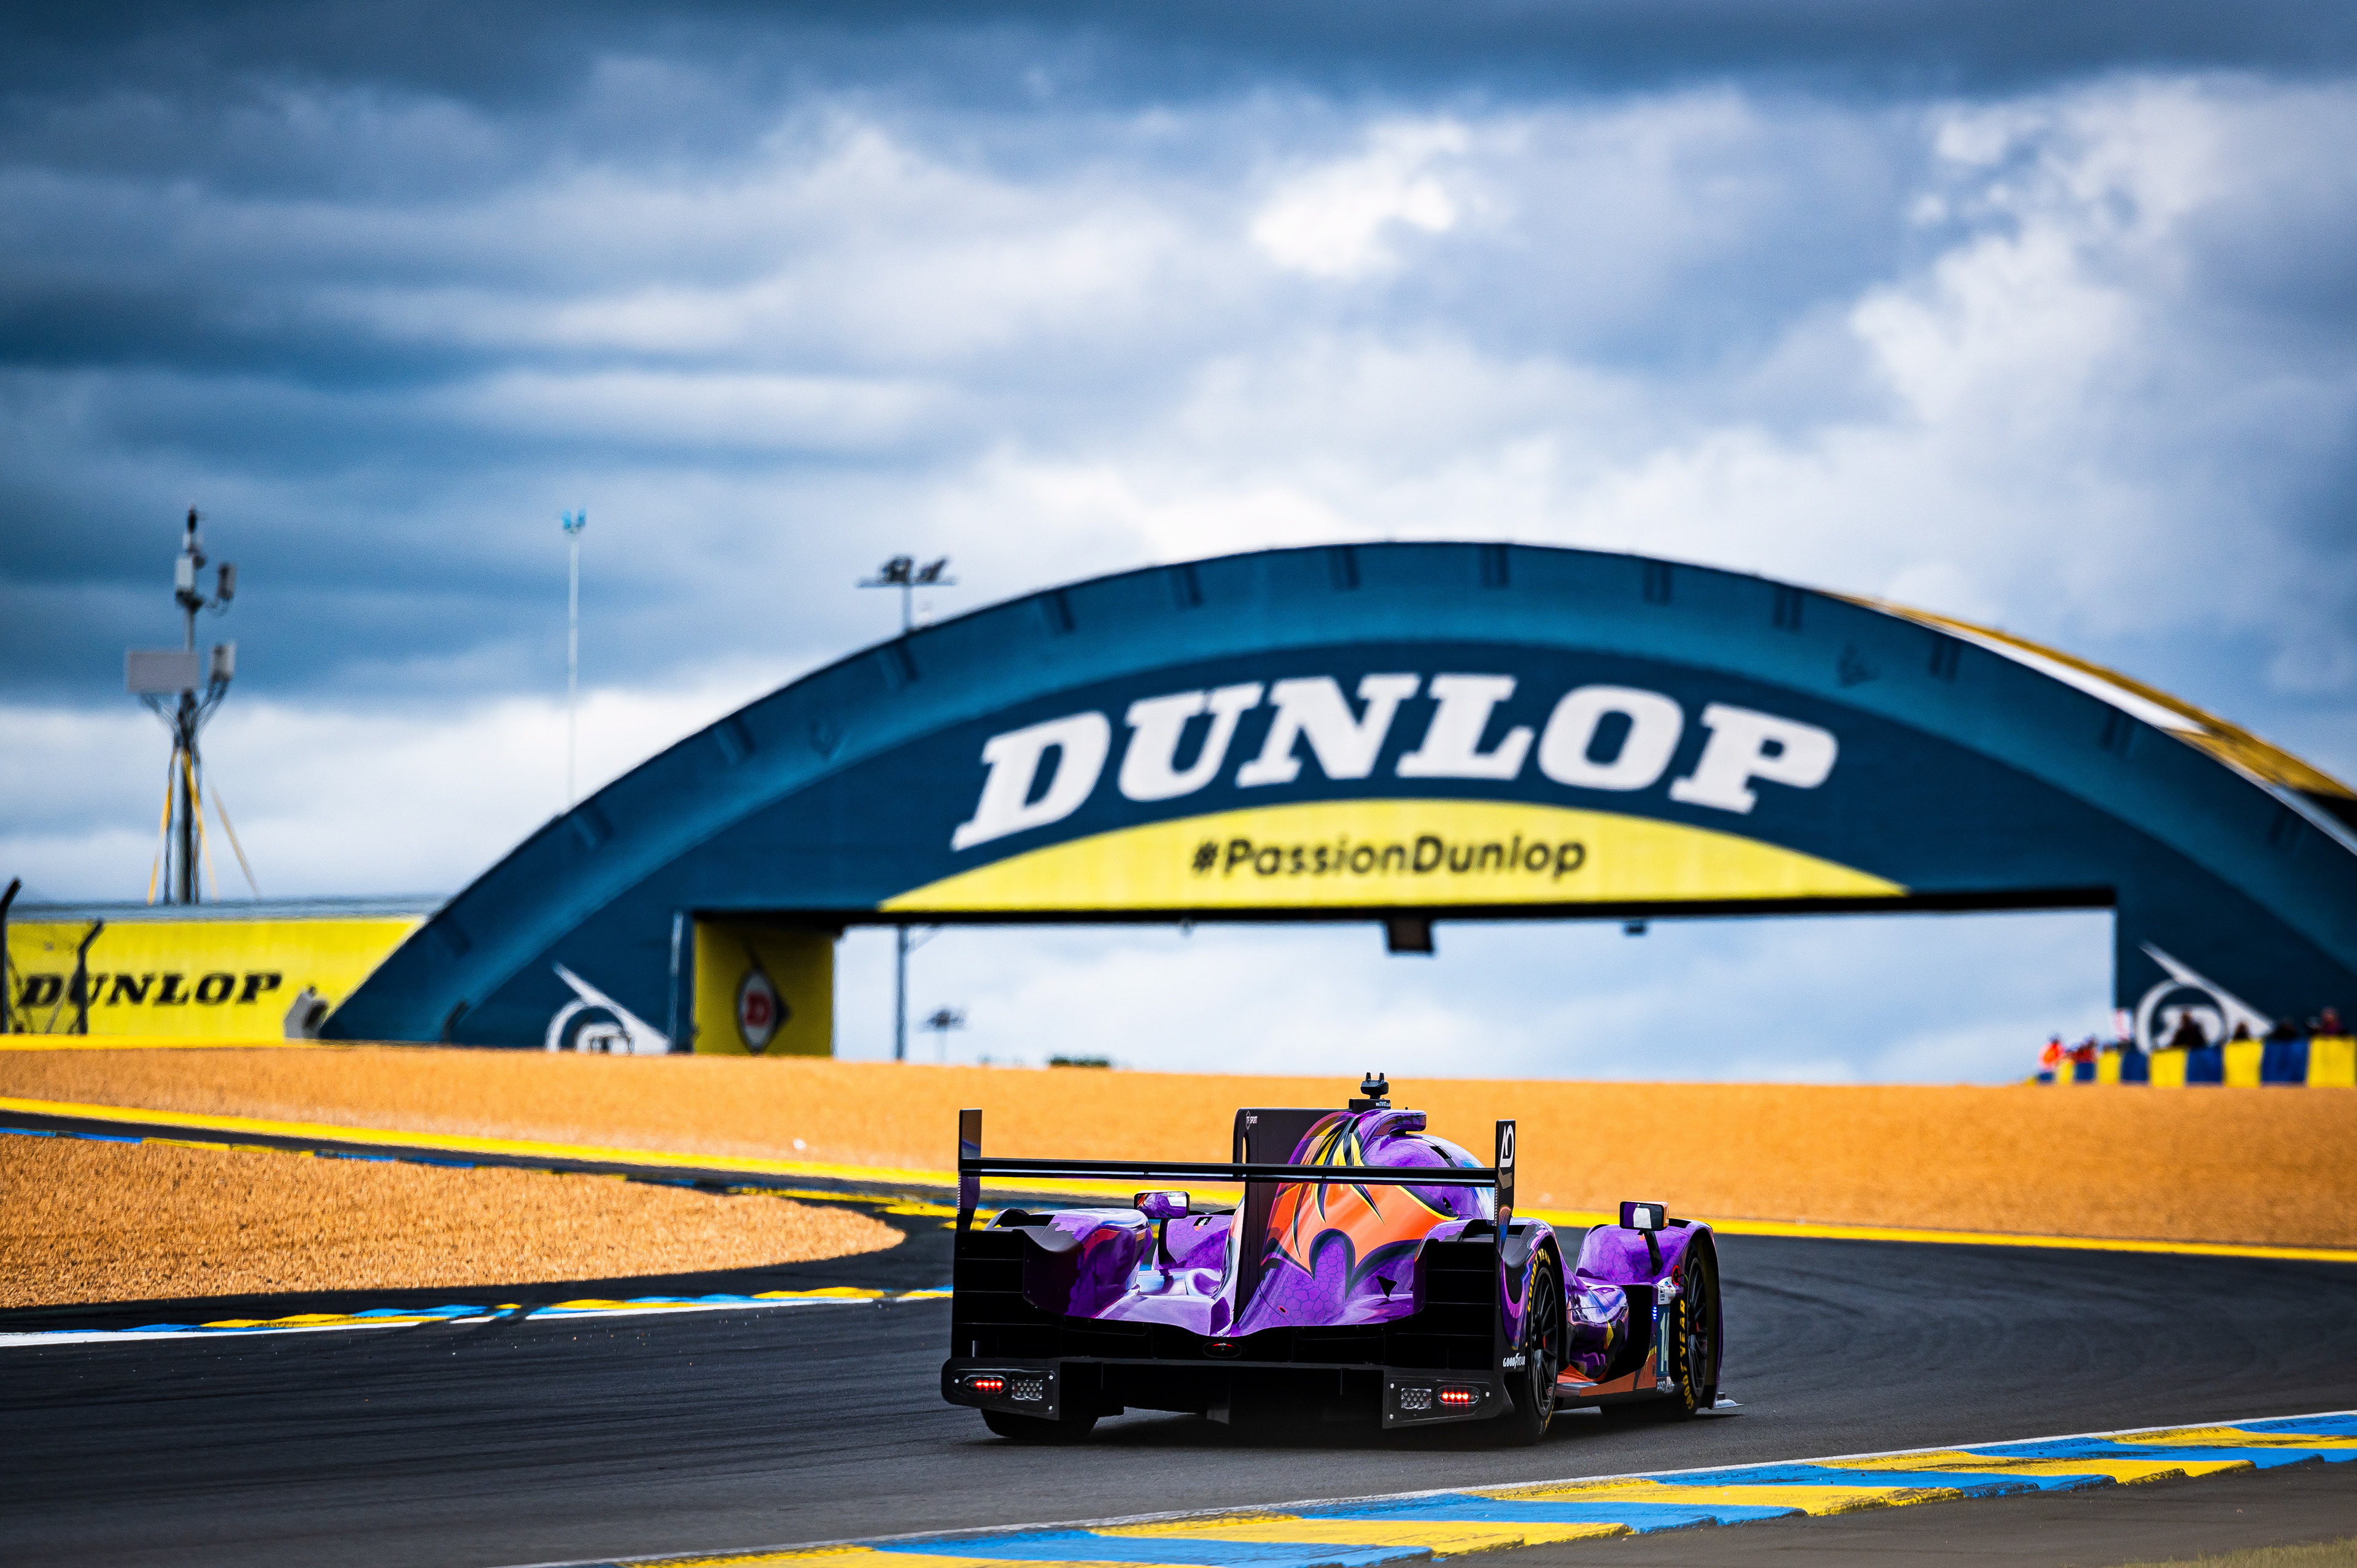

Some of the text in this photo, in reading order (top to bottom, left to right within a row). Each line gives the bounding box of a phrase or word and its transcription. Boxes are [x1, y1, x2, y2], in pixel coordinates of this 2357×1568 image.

[951, 673, 1838, 852] DUNLOP
[1191, 834, 1586, 881] #PassionDunlop
[18, 971, 282, 1008] DUNLOP
